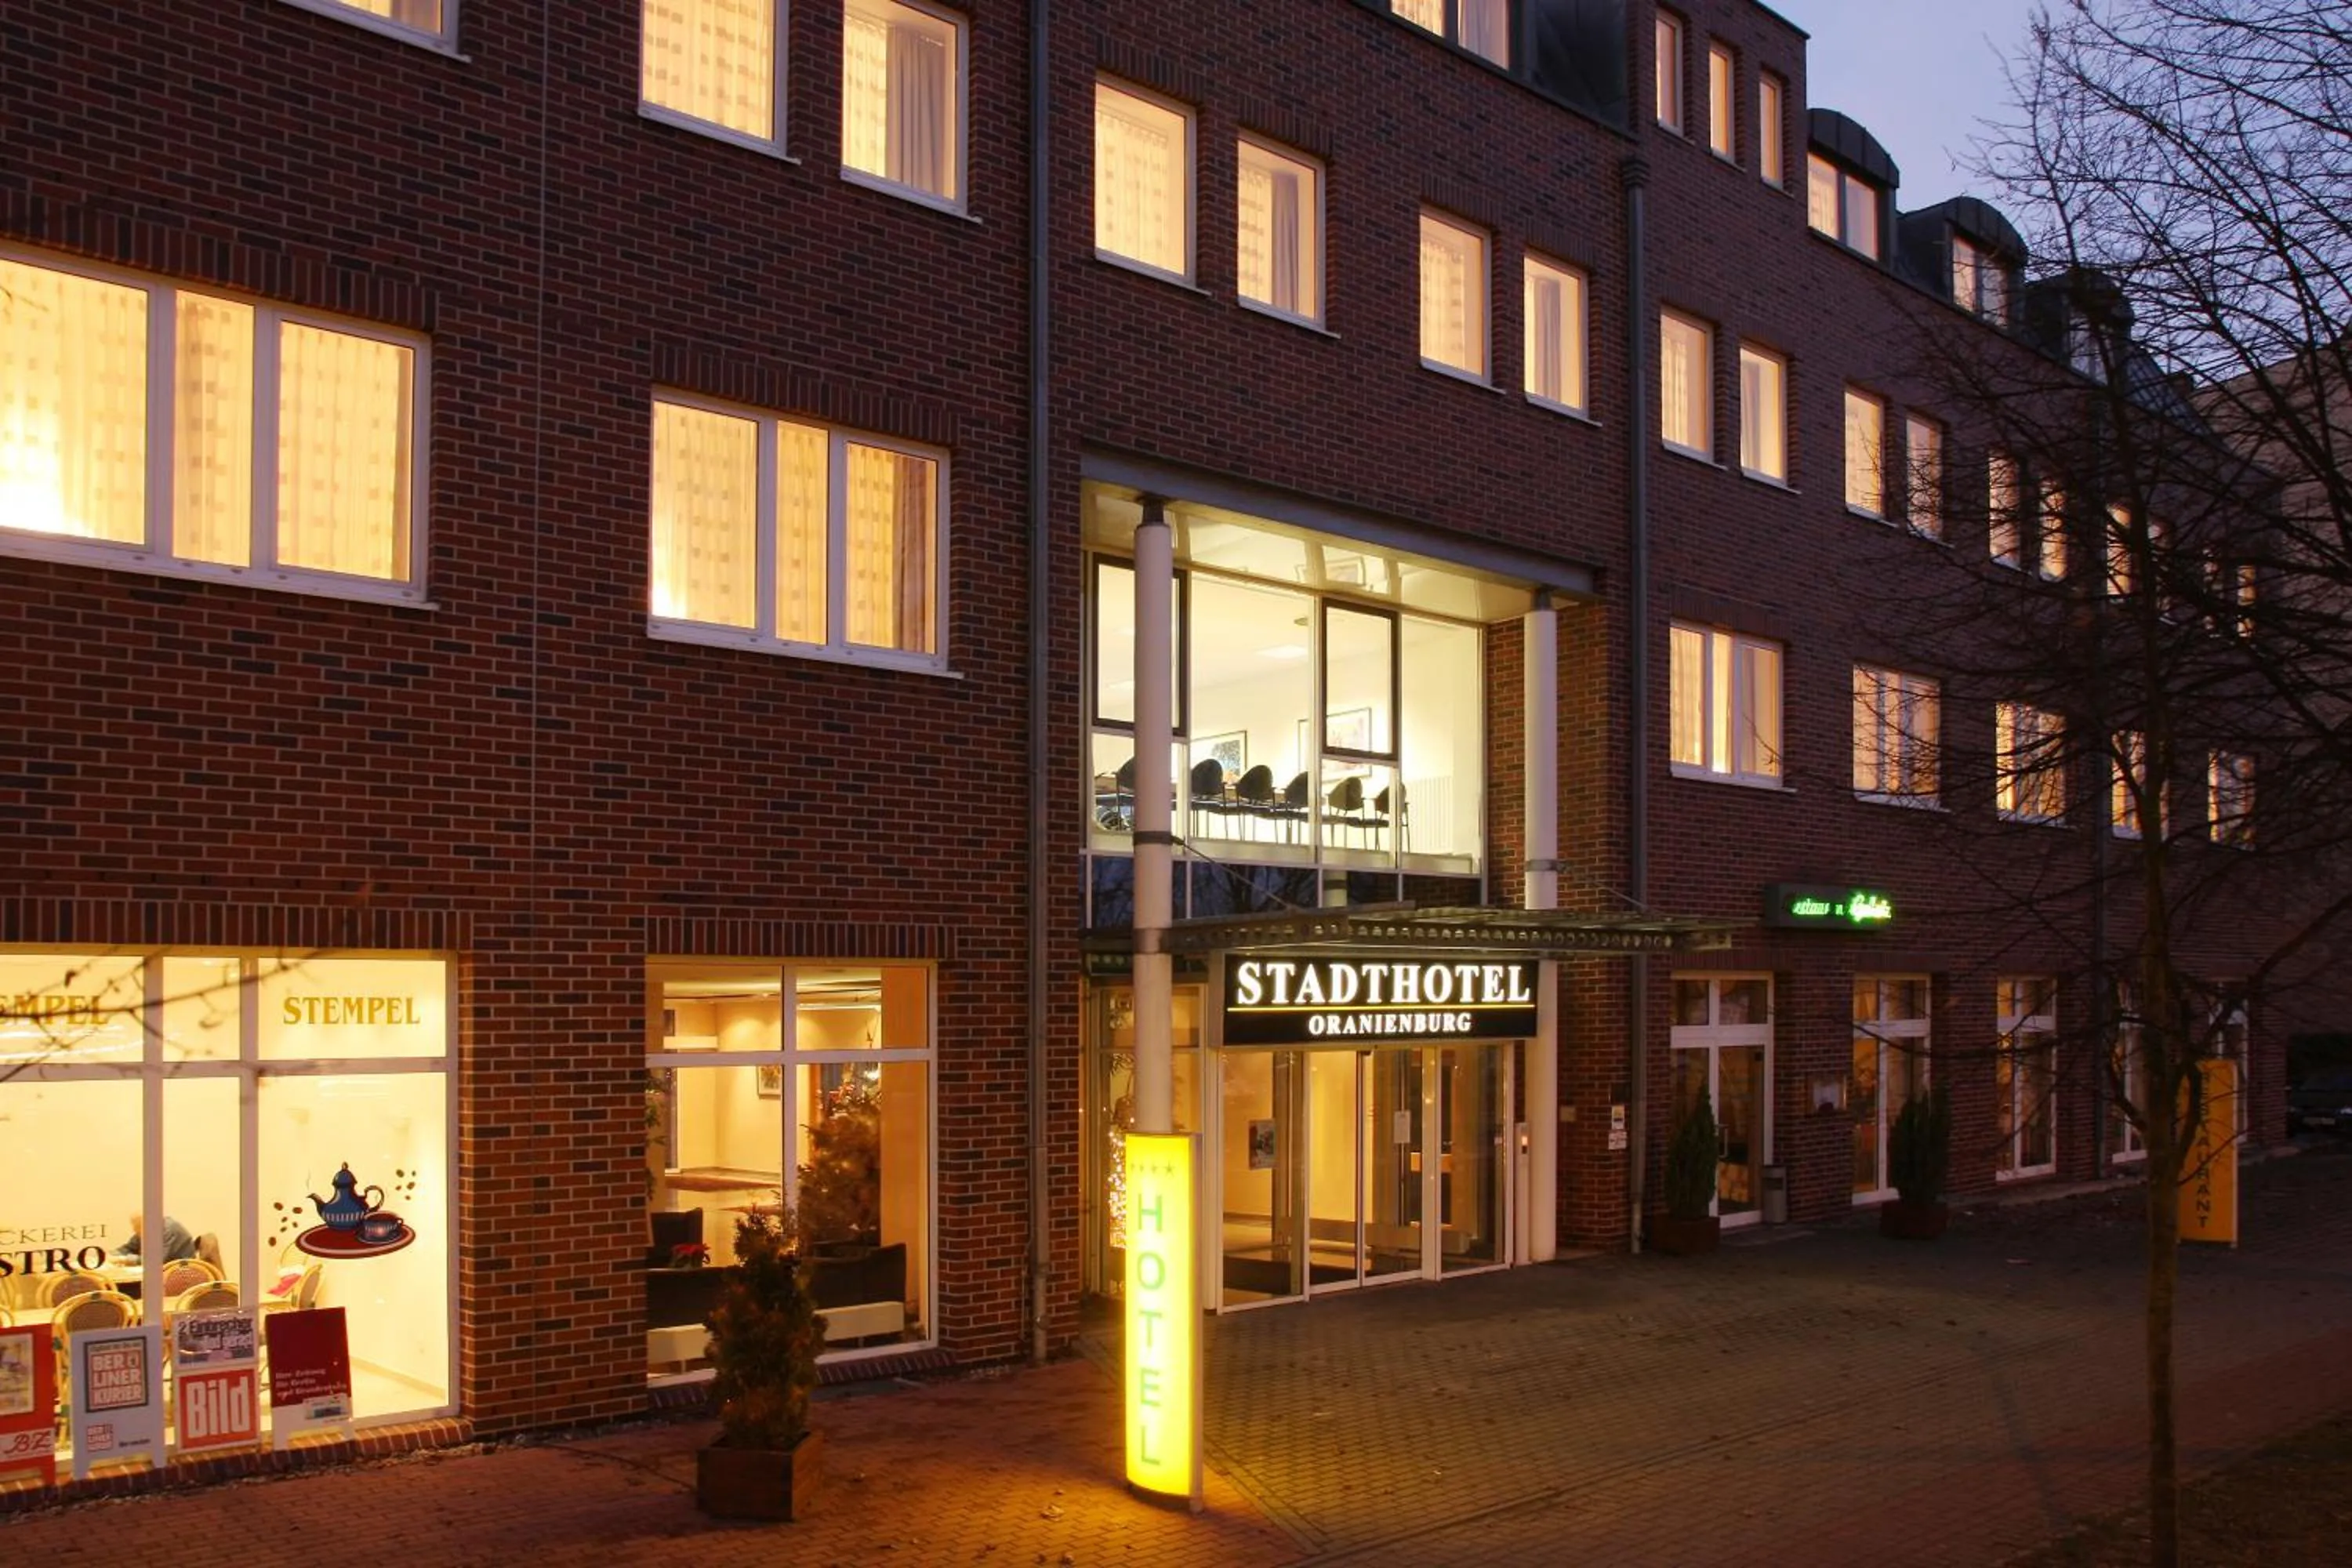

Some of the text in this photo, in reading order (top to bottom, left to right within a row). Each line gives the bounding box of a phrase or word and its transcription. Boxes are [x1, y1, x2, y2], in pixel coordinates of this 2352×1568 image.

[1236, 963, 1530, 1005] STADTHOTEL
[283, 996, 420, 1025] STEMPEL
[1308, 1013, 1472, 1036] ORANIENBURG
[1136, 1193, 1166, 1465] HOTEL
[93, 1355, 125, 1371] BER
[186, 1375, 251, 1439] Bild
